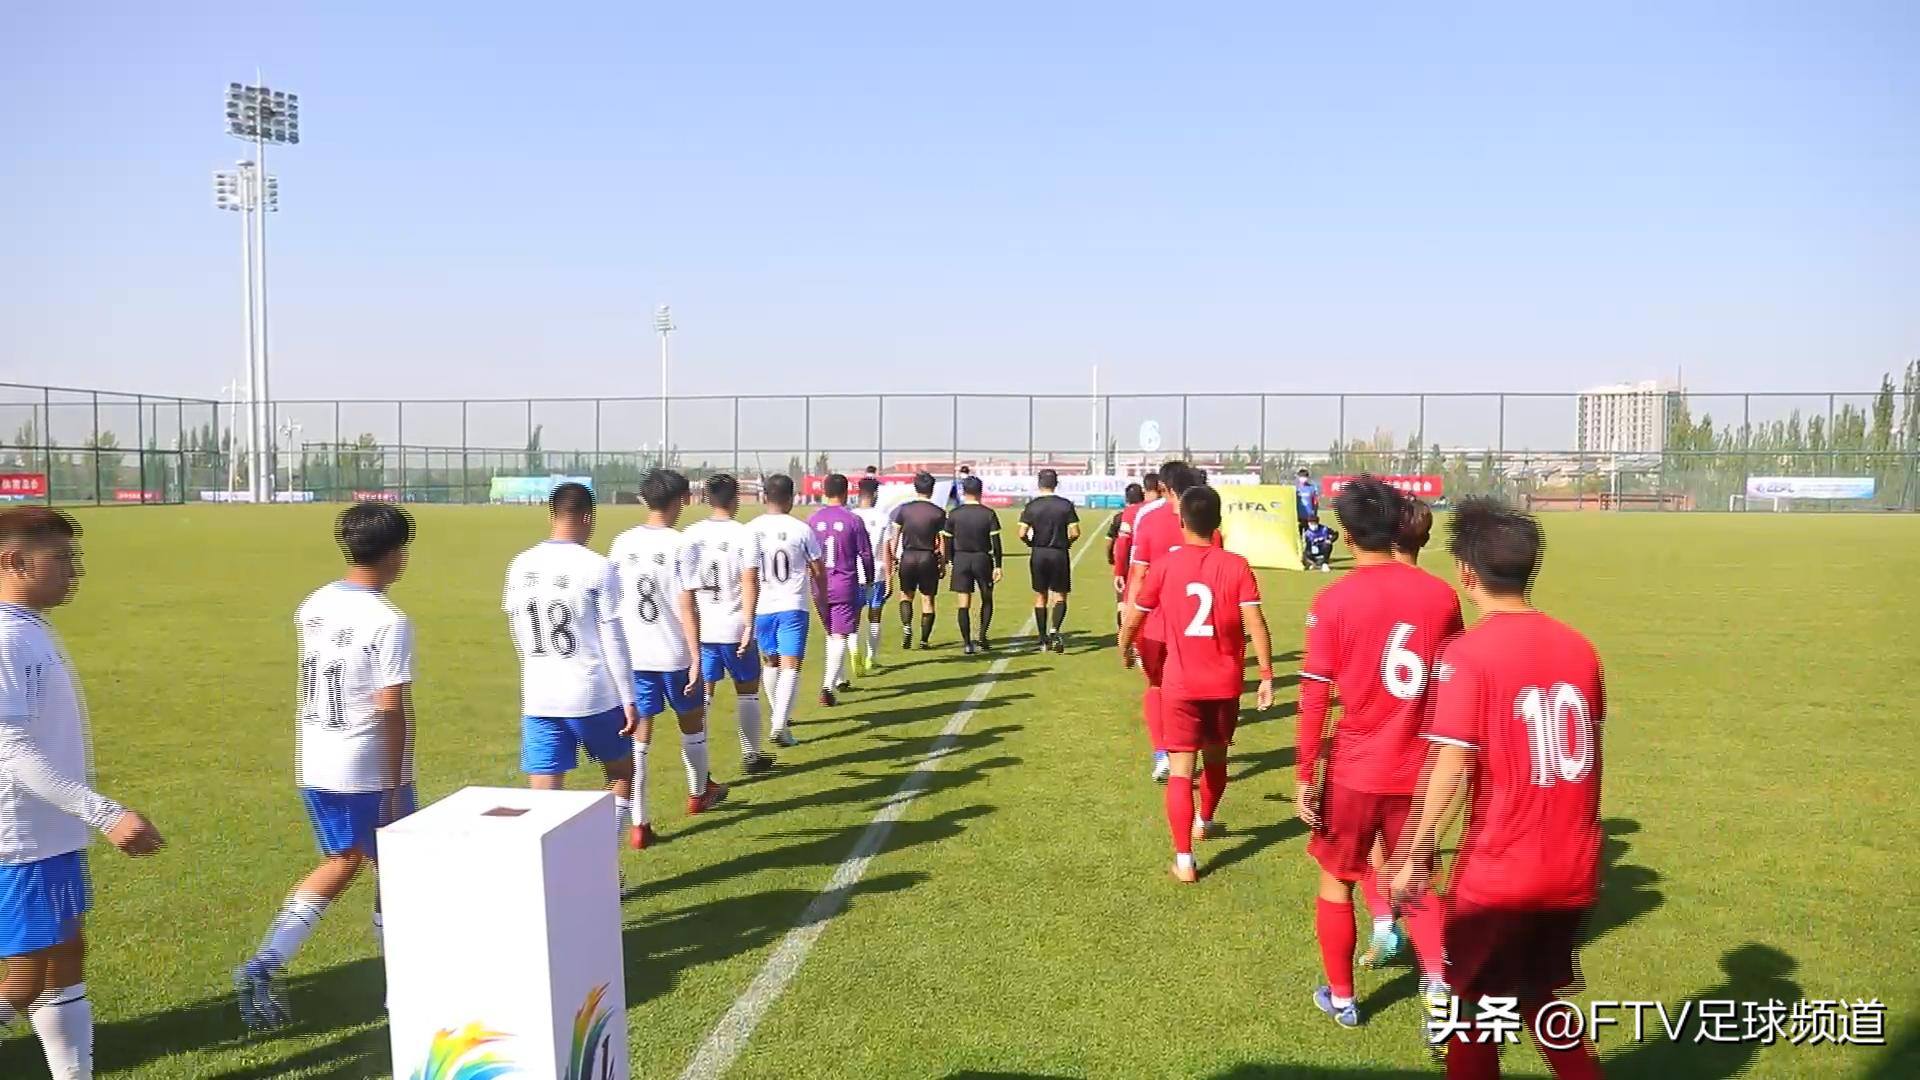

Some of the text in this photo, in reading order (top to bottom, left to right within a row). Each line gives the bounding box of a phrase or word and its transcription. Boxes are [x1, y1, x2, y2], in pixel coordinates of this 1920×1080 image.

[759, 549, 790, 584] 10
[823, 535, 837, 569] 1
[636, 574, 661, 624] 8
[700, 559, 722, 604] 4
[525, 597, 579, 659] 18
[1183, 582, 1215, 637] 2
[1380, 621, 1430, 700] 6
[301, 653, 349, 730] 11
[1513, 681, 1595, 787] 10
